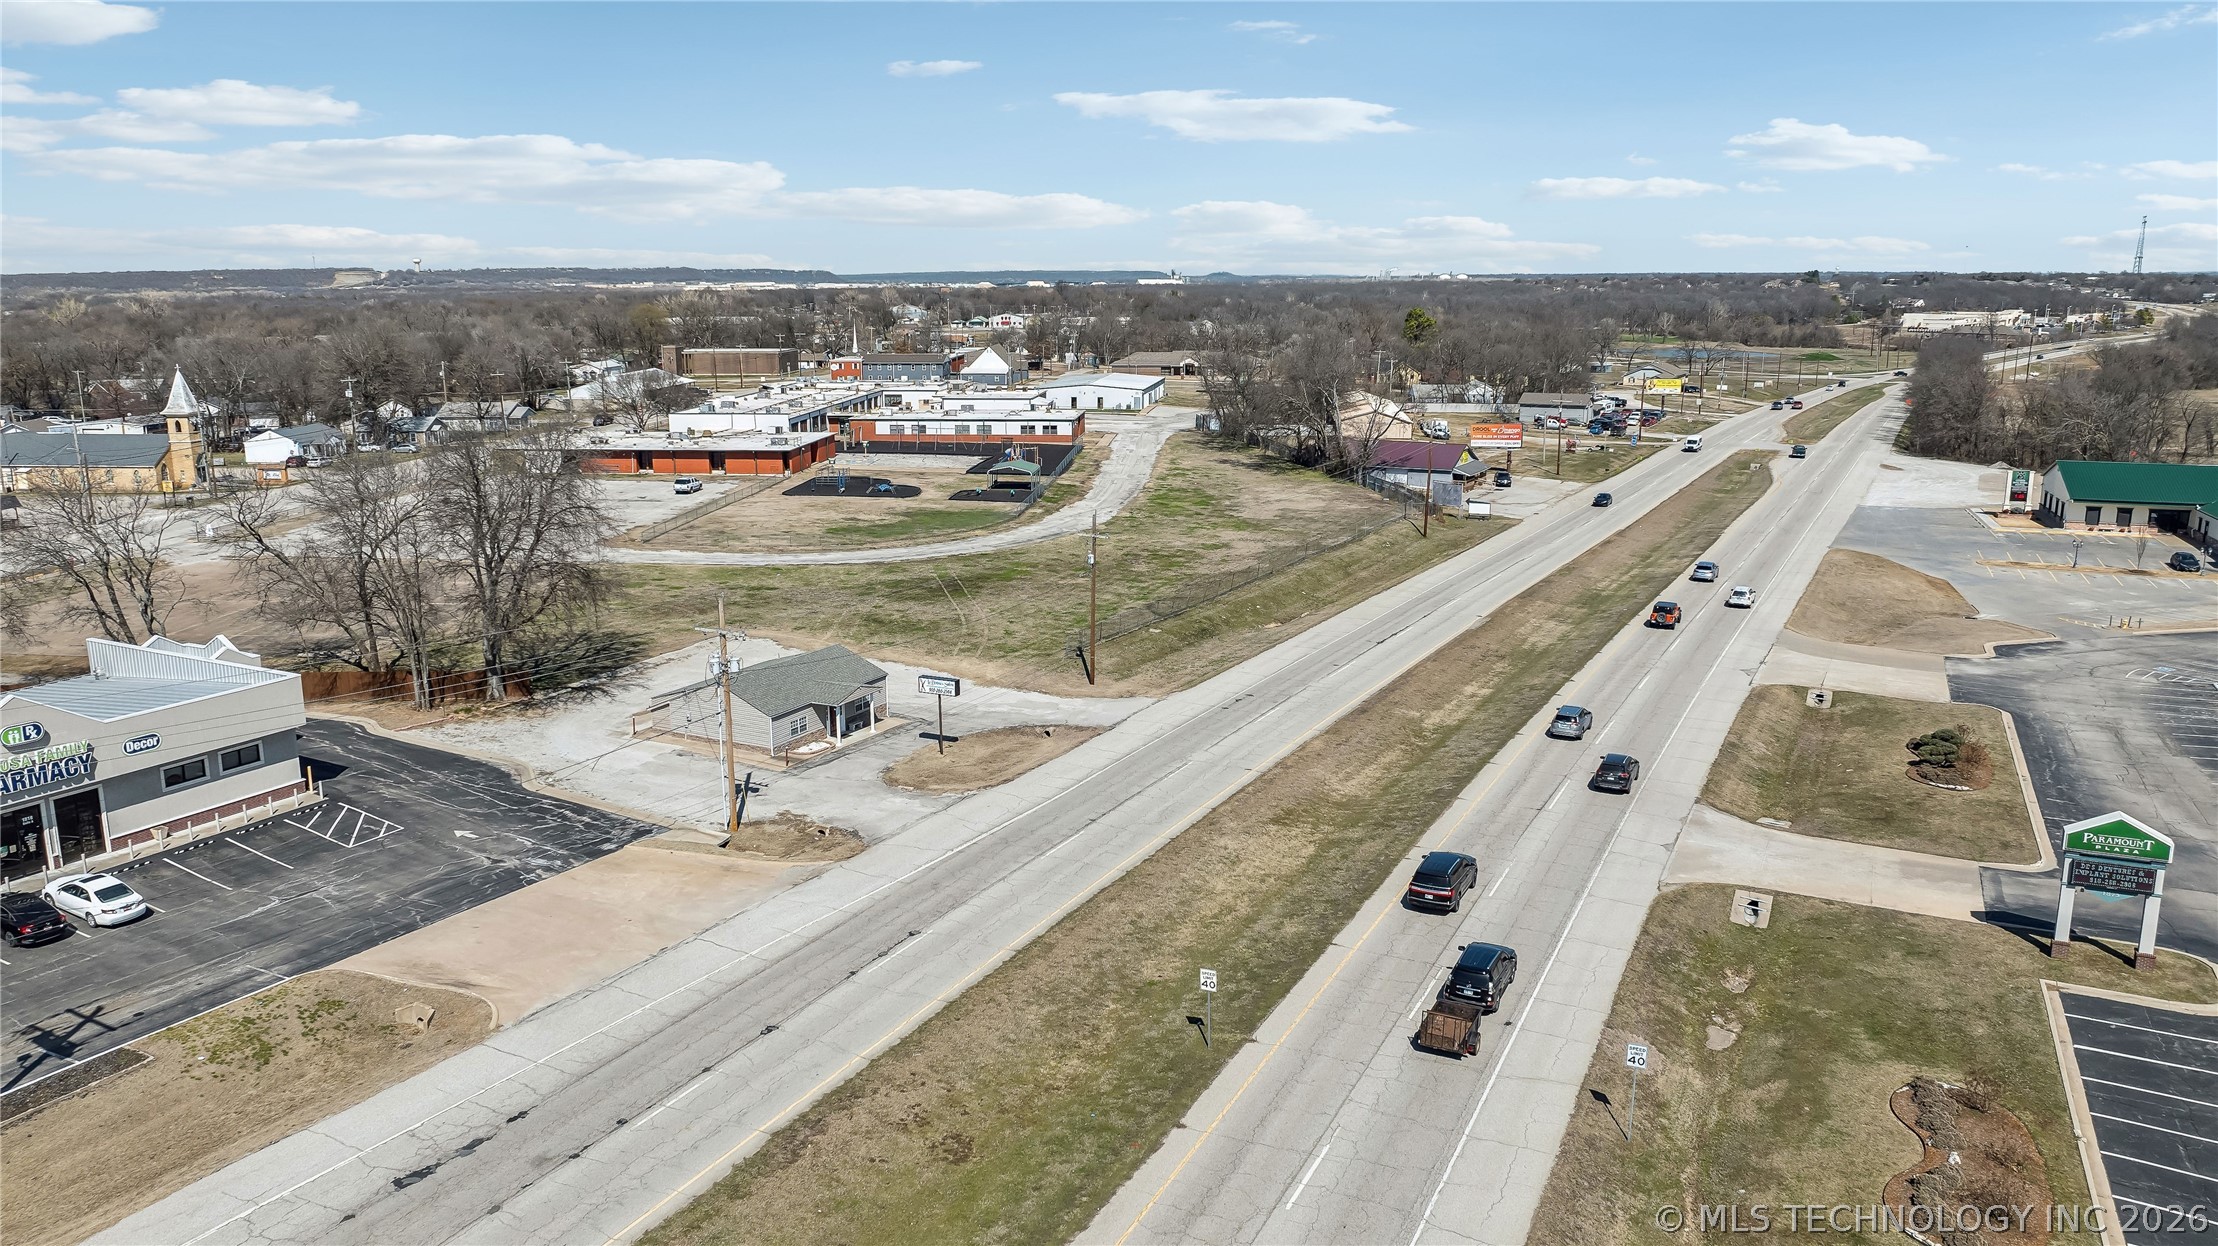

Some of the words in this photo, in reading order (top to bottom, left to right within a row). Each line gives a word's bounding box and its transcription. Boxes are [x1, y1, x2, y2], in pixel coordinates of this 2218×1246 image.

[125, 736, 159, 753] Decor
[35, 739, 89, 763] FAMILY
[2095, 844, 2140, 855] PLAZA
[2111, 873, 2153, 885] SOLUTIONS
[1201, 980, 1216, 989] 40
[1629, 1045, 1647, 1053] SPEED
[1627, 1056, 1646, 1066] 40
